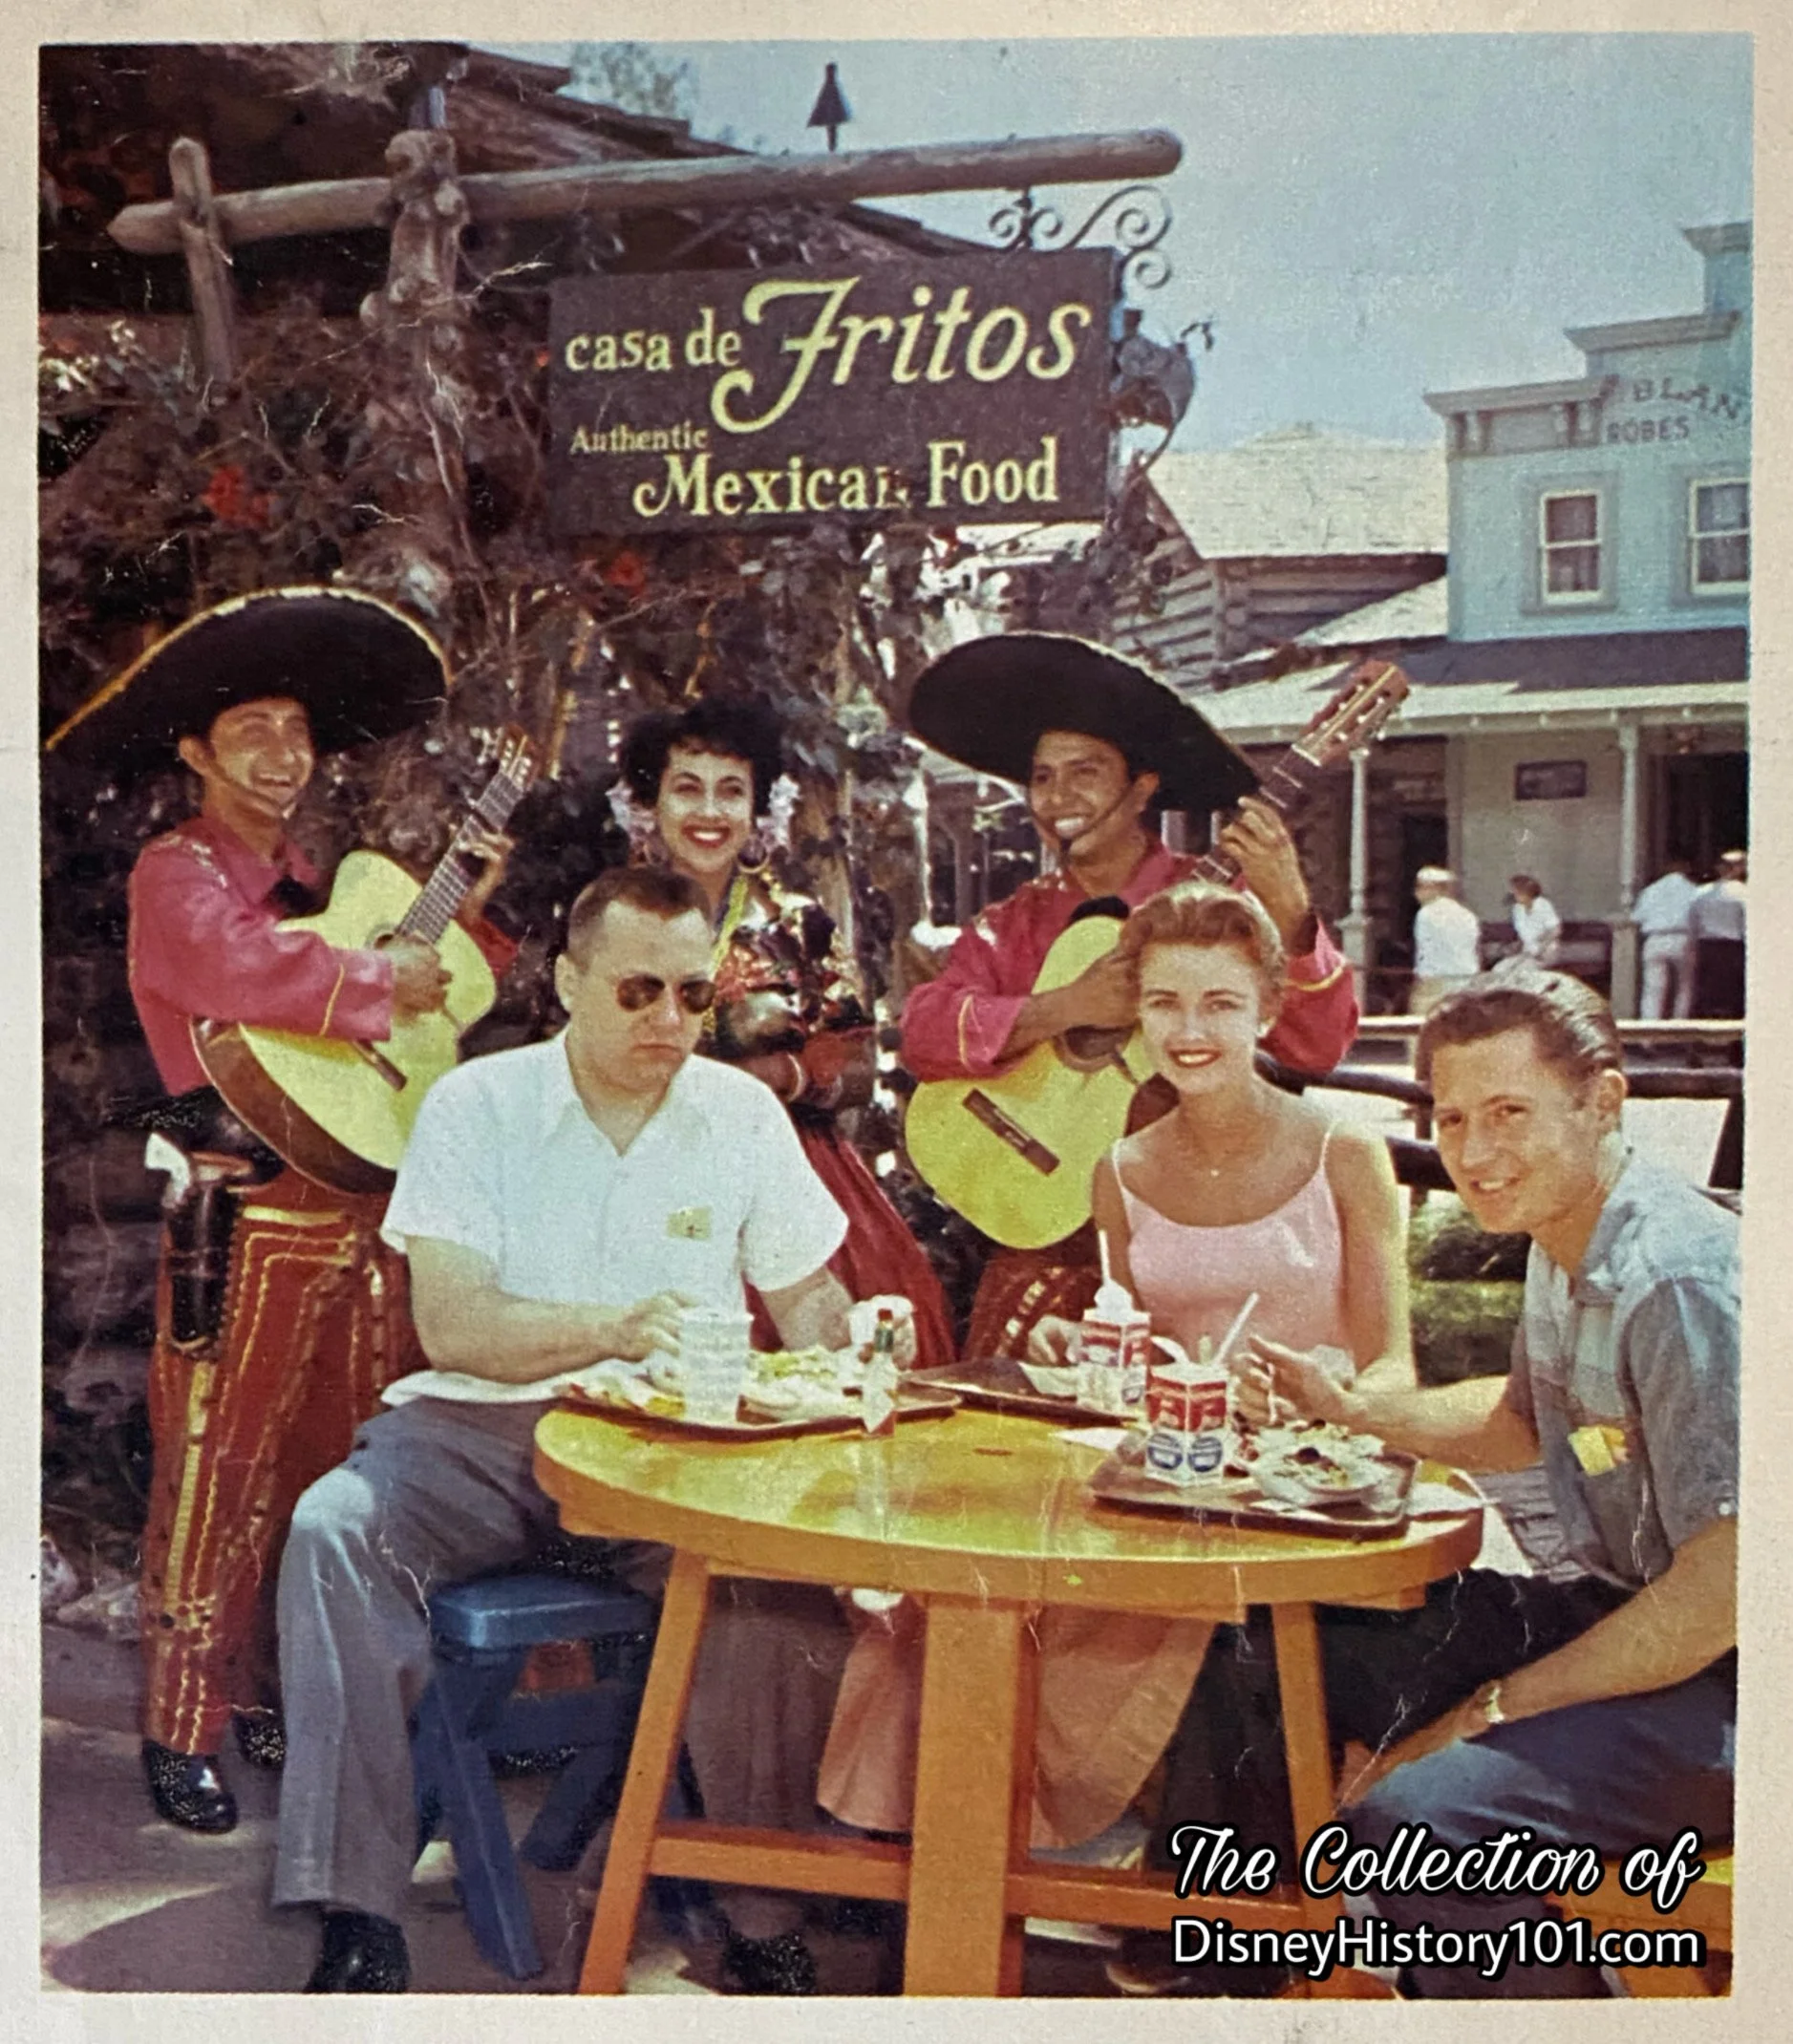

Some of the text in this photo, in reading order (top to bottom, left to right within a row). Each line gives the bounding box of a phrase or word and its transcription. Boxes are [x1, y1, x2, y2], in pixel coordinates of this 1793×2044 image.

[565, 276, 1092, 434] casa de Fritos
[570, 421, 709, 454] Authentic
[926, 436, 1060, 508] Food
